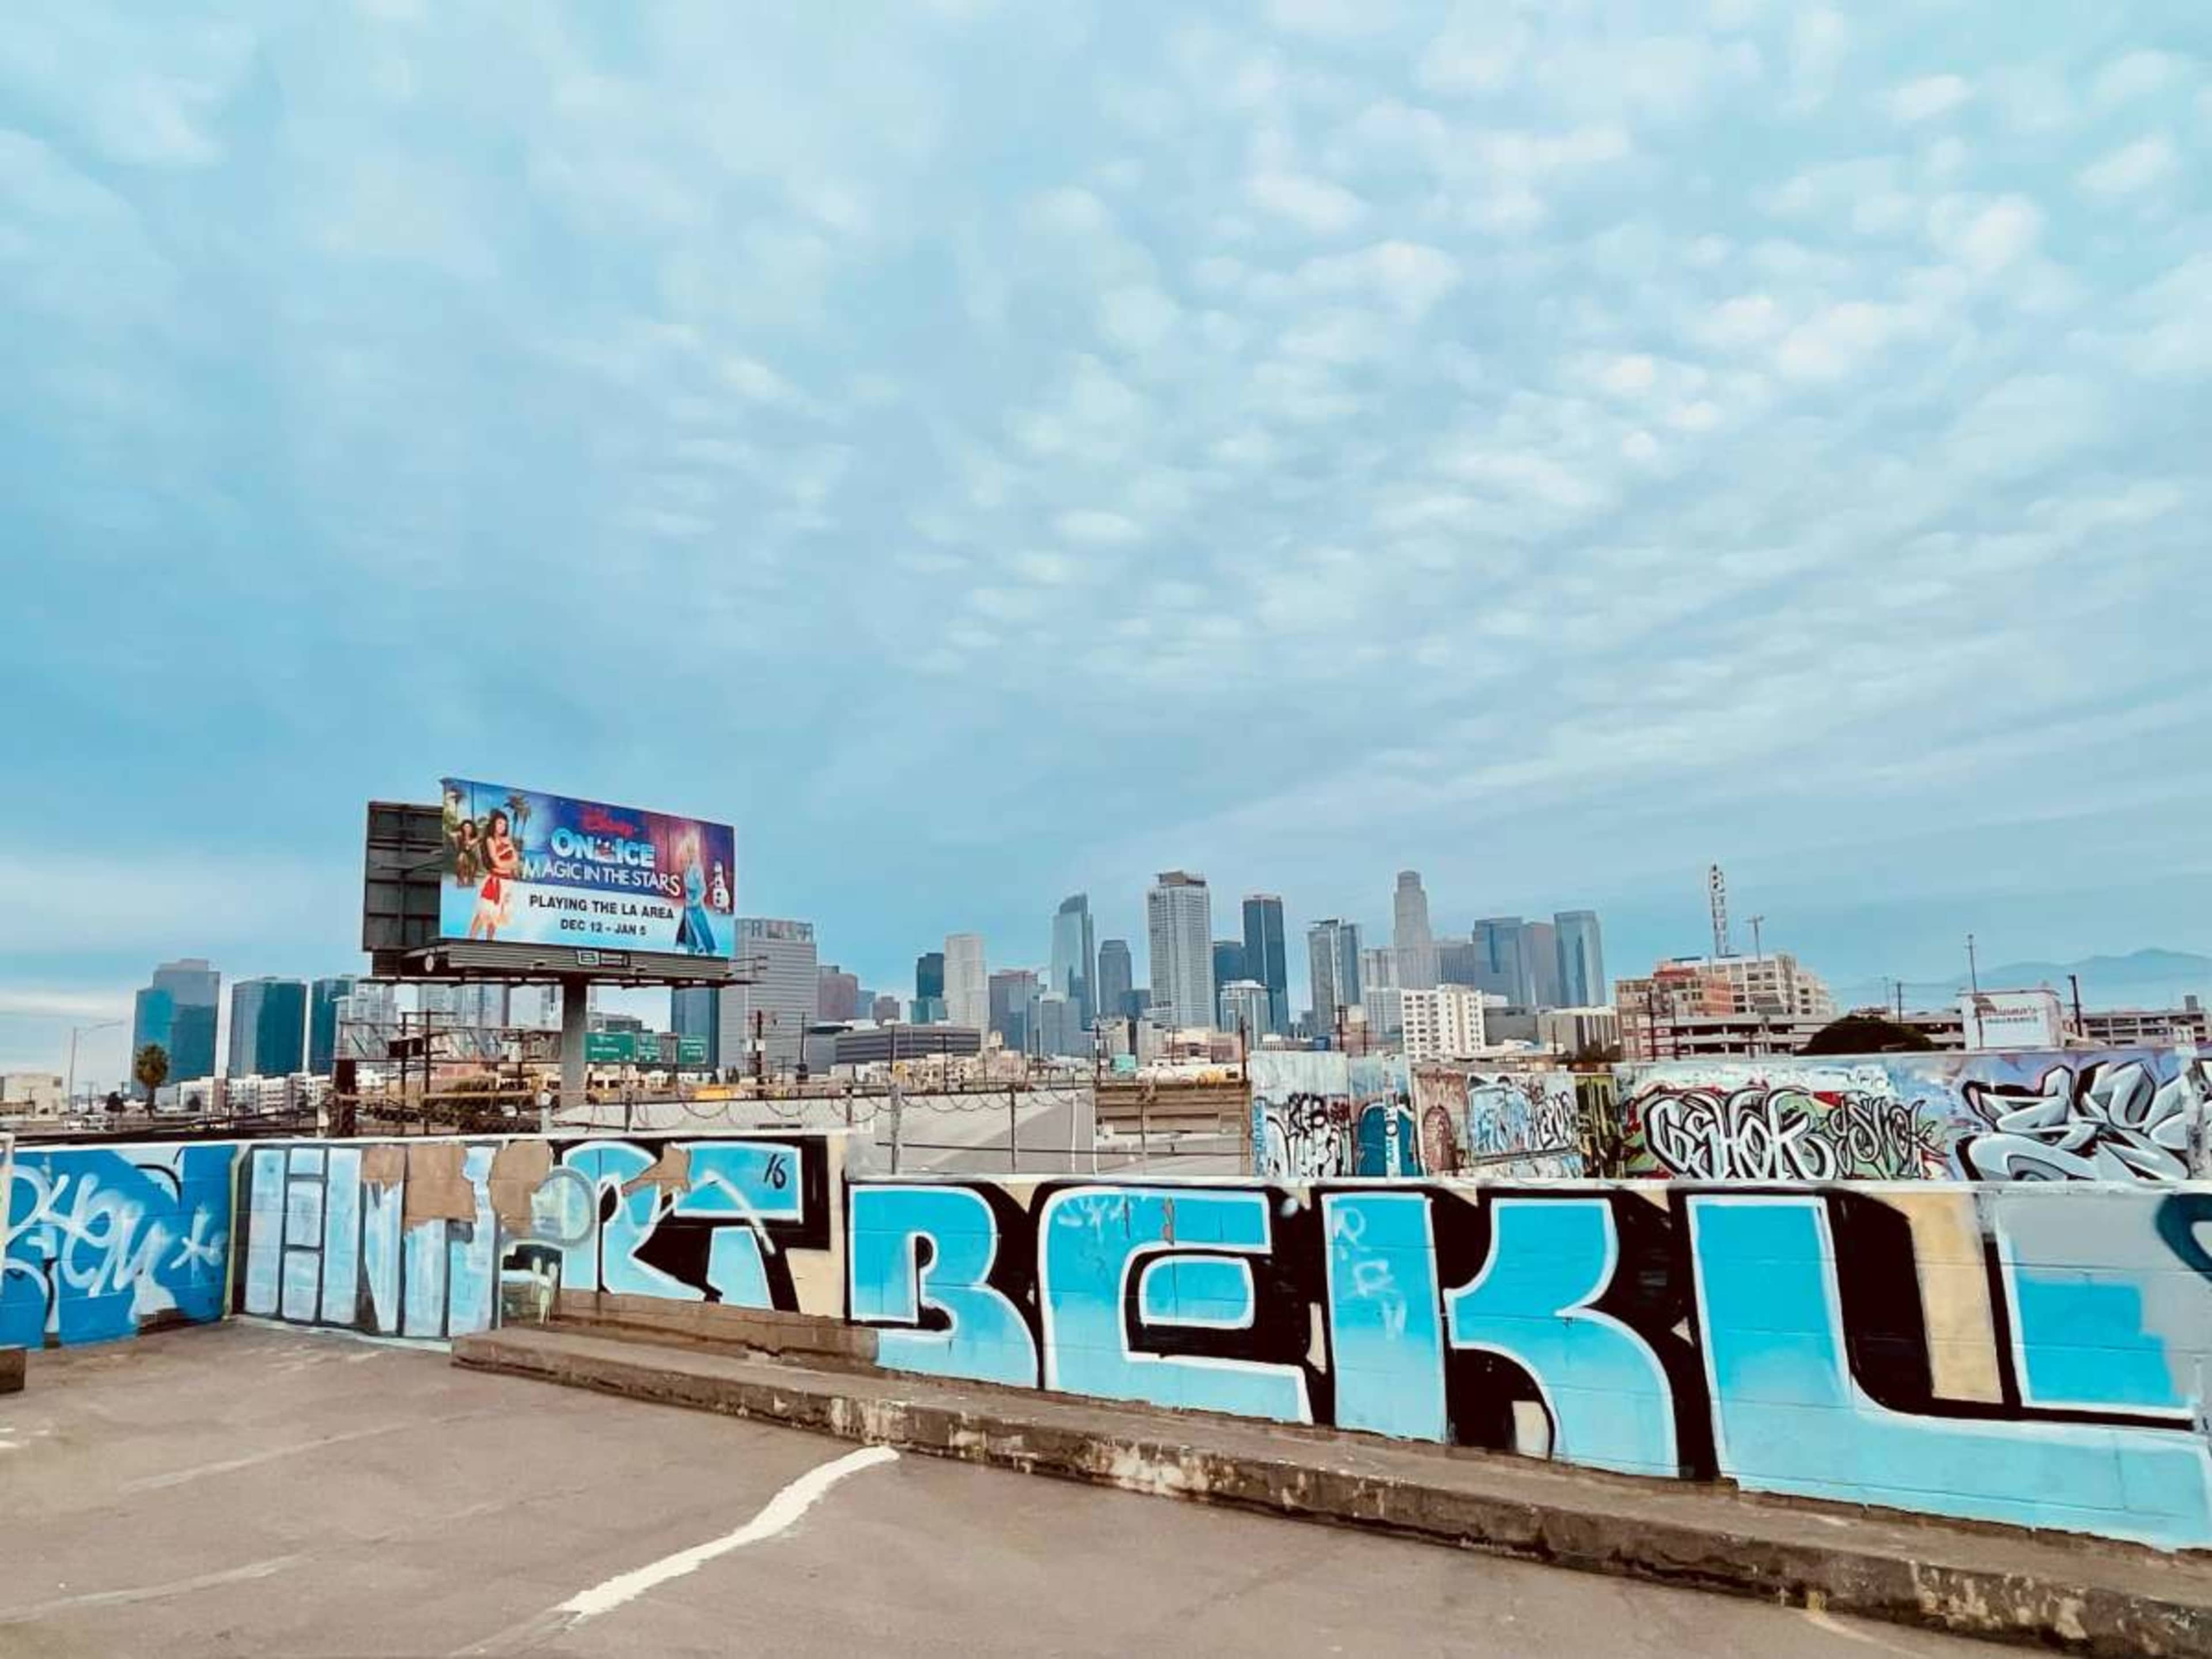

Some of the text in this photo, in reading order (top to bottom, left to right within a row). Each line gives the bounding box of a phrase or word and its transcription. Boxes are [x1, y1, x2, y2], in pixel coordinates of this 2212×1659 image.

[550, 827, 656, 868] ON ICE
[522, 858, 681, 896] MAGIC IN THE STARS
[529, 895, 674, 919] PLAYING THE LA AREA
[560, 919, 586, 931] DEC
[590, 922, 602, 933] 12
[615, 923, 637, 935] JAN
